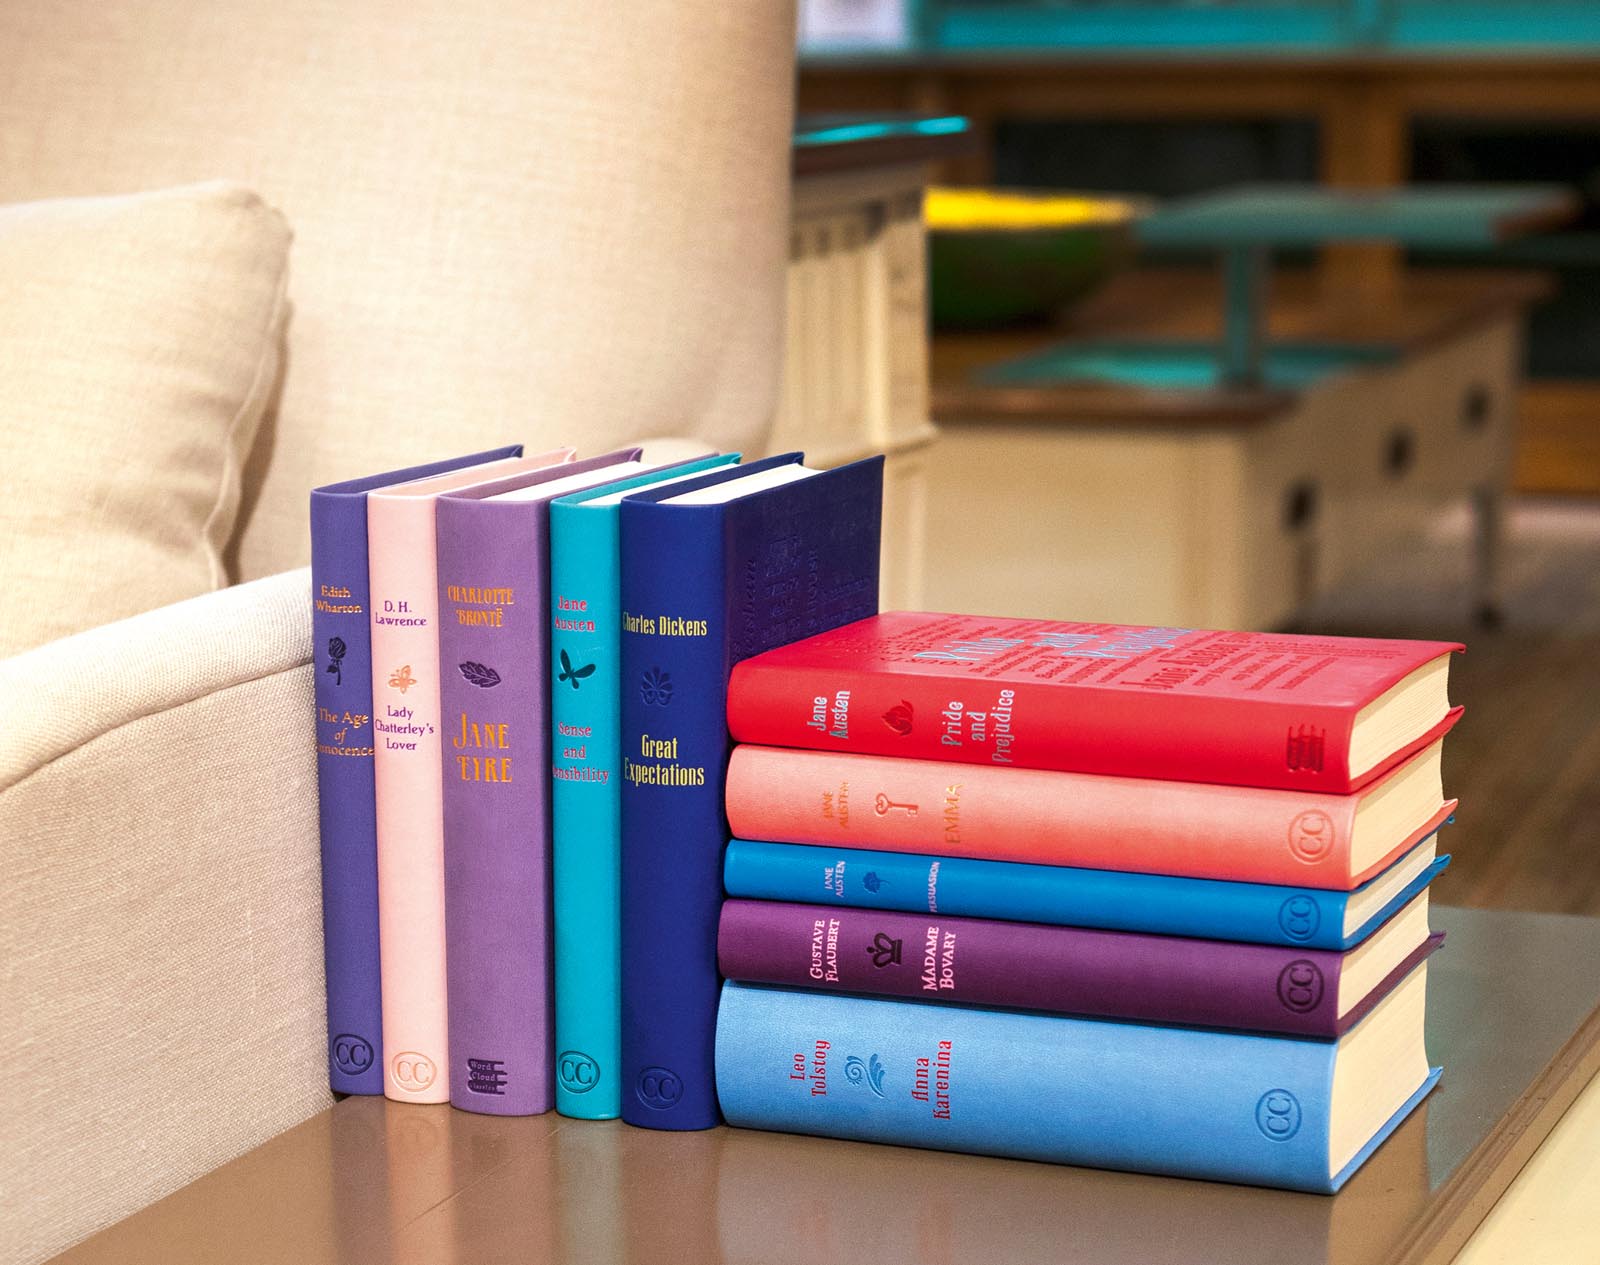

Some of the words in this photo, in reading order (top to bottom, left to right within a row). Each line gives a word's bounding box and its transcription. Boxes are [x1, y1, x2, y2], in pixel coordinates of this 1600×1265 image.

[321, 584, 352, 598] Edith
[447, 585, 514, 605] CHARLOTTE
[557, 595, 588, 612] Jane
[315, 599, 363, 614] Wharton
[375, 612, 427, 627] Lawrence
[554, 616, 596, 632] Austen
[622, 611, 655, 635] Charles
[659, 615, 708, 637] Dickens
[319, 708, 338, 722] The
[342, 712, 369, 729] Age
[387, 705, 414, 721] Lady
[806, 696, 828, 731] Jane
[829, 690, 851, 739] Austen
[941, 700, 964, 747] Pride
[990, 689, 1016, 763] Prejudice
[334, 728, 346, 745] of
[374, 719, 435, 737] Chatterley's
[453, 711, 510, 749] JANE
[557, 721, 593, 737] Sense
[966, 711, 987, 742] and
[386, 738, 417, 751] Lover
[563, 744, 587, 759] and
[641, 733, 678, 760] Great
[456, 755, 513, 783] EYRE
[552, 765, 609, 785] ensibility
[624, 757, 706, 787] Expectations
[943, 783, 964, 844] EMMA
[824, 866, 834, 890] JANE
[835, 860, 846, 898] AUSTEN
[809, 919, 826, 979] GUSTAVE
[825, 918, 841, 983] FLAUBERT
[921, 926, 940, 992] MADAME
[939, 931, 957, 990] BOVARY
[336, 1042, 367, 1067] CC
[470, 1060, 493, 1071] Word
[789, 1053, 806, 1081] Leo
[396, 1060, 430, 1084] CC
[471, 1071, 496, 1082] Cloud
[561, 1060, 592, 1085] CC
[809, 1039, 831, 1097] Tolstoy
[911, 1057, 930, 1102] Anna
[933, 1039, 952, 1121] Karenina
[1266, 1097, 1292, 1135] CC
